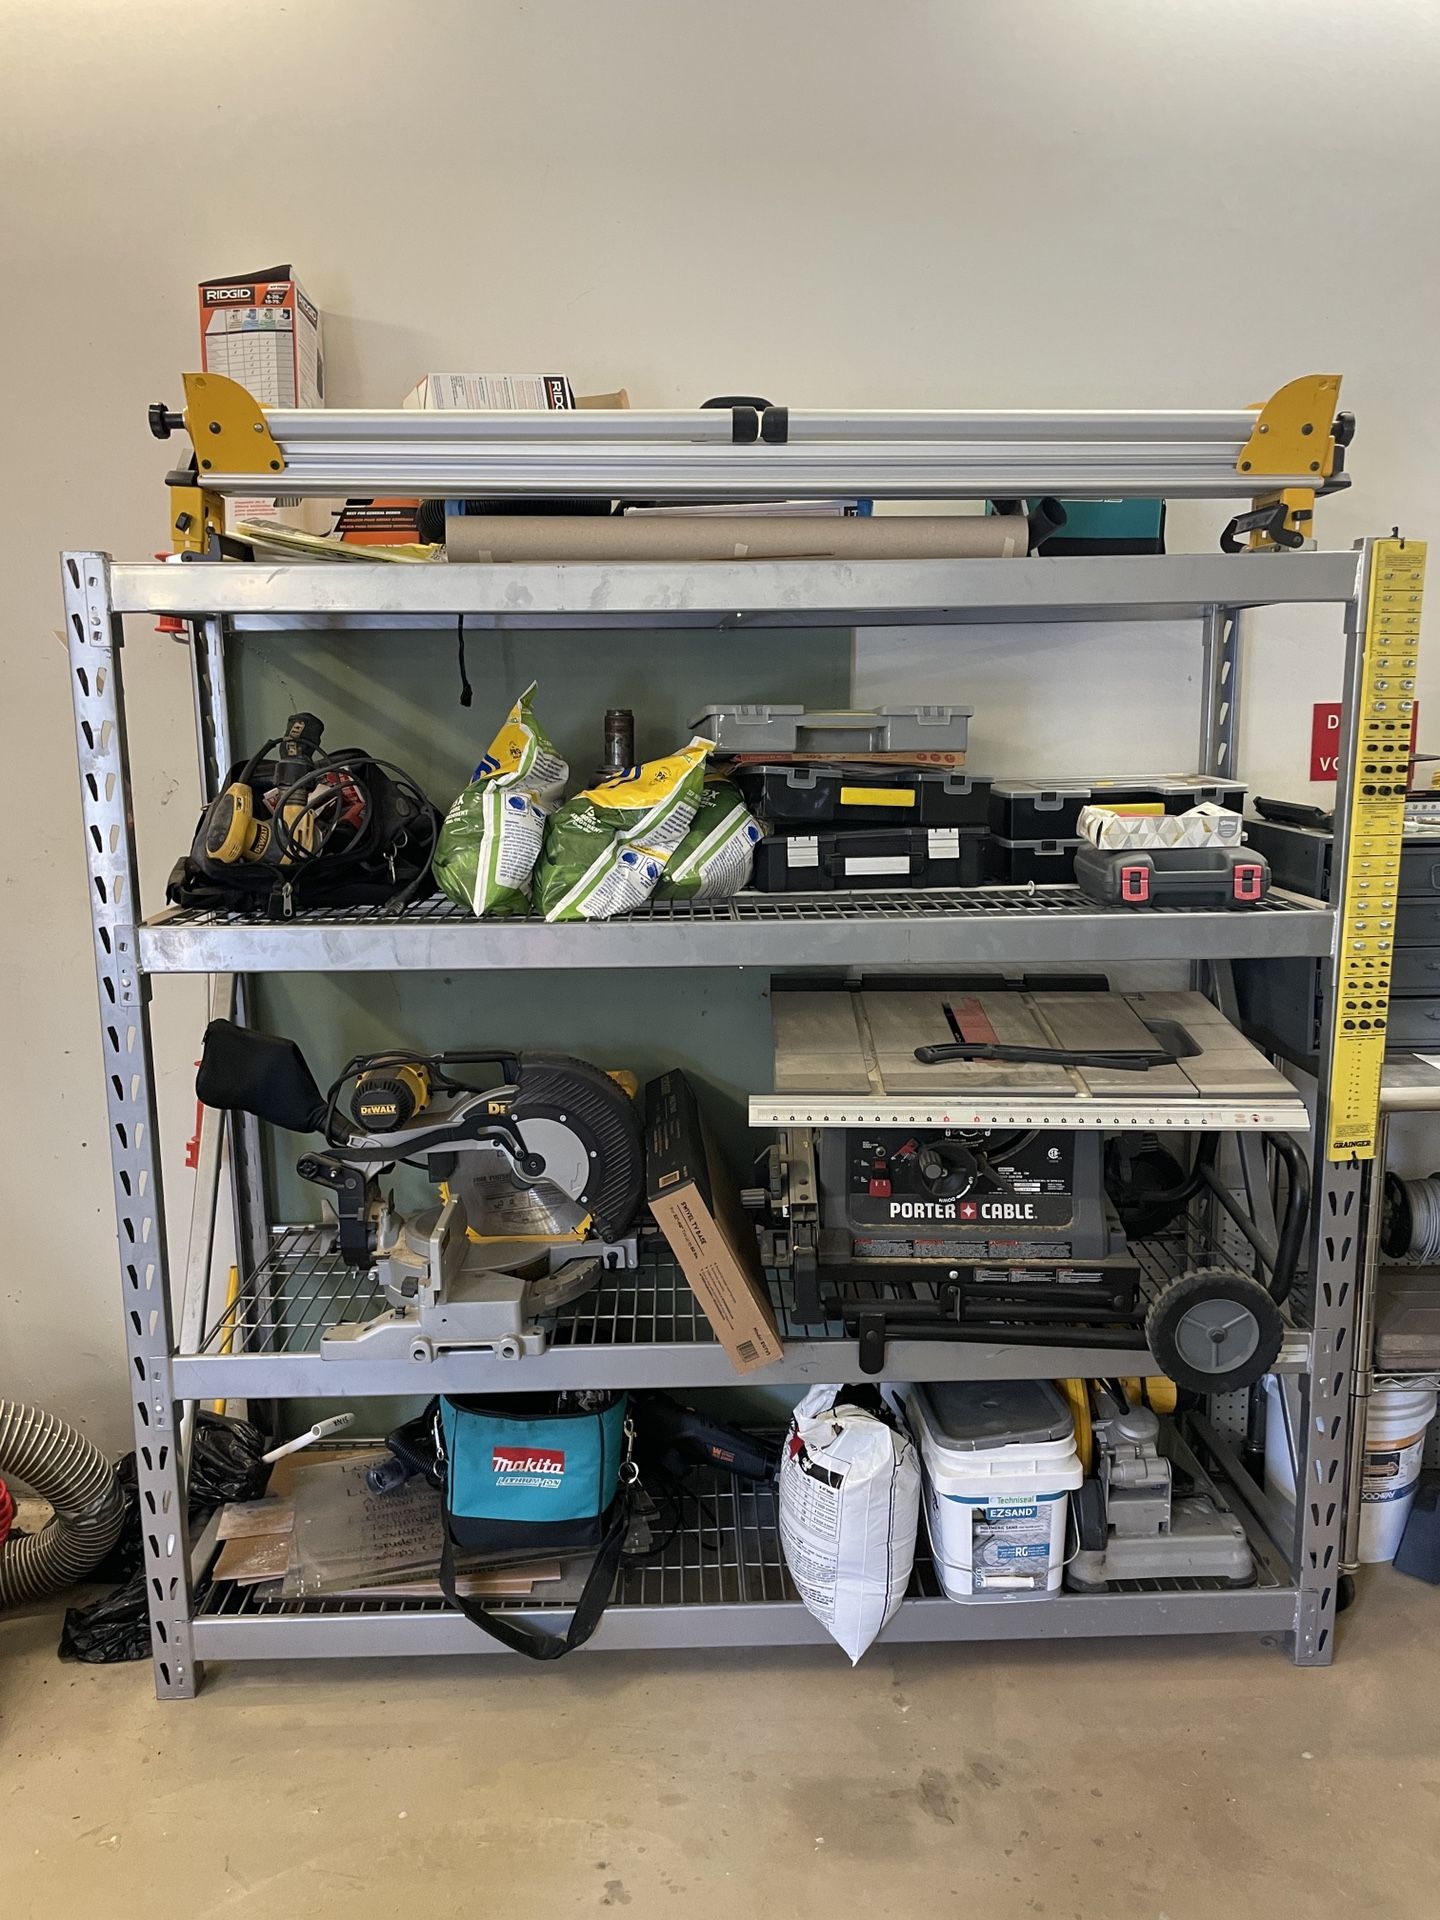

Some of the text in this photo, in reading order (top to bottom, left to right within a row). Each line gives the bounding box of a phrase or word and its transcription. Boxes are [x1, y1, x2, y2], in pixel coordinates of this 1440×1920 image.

[206, 289, 251, 300] RIDGID
[1333, 1140, 1371, 1149] GRAINGER
[890, 1203, 1034, 1219] PORTER CABLE
[997, 1496, 1035, 1504] Techniseal
[1015, 1546, 1029, 1557] RG
